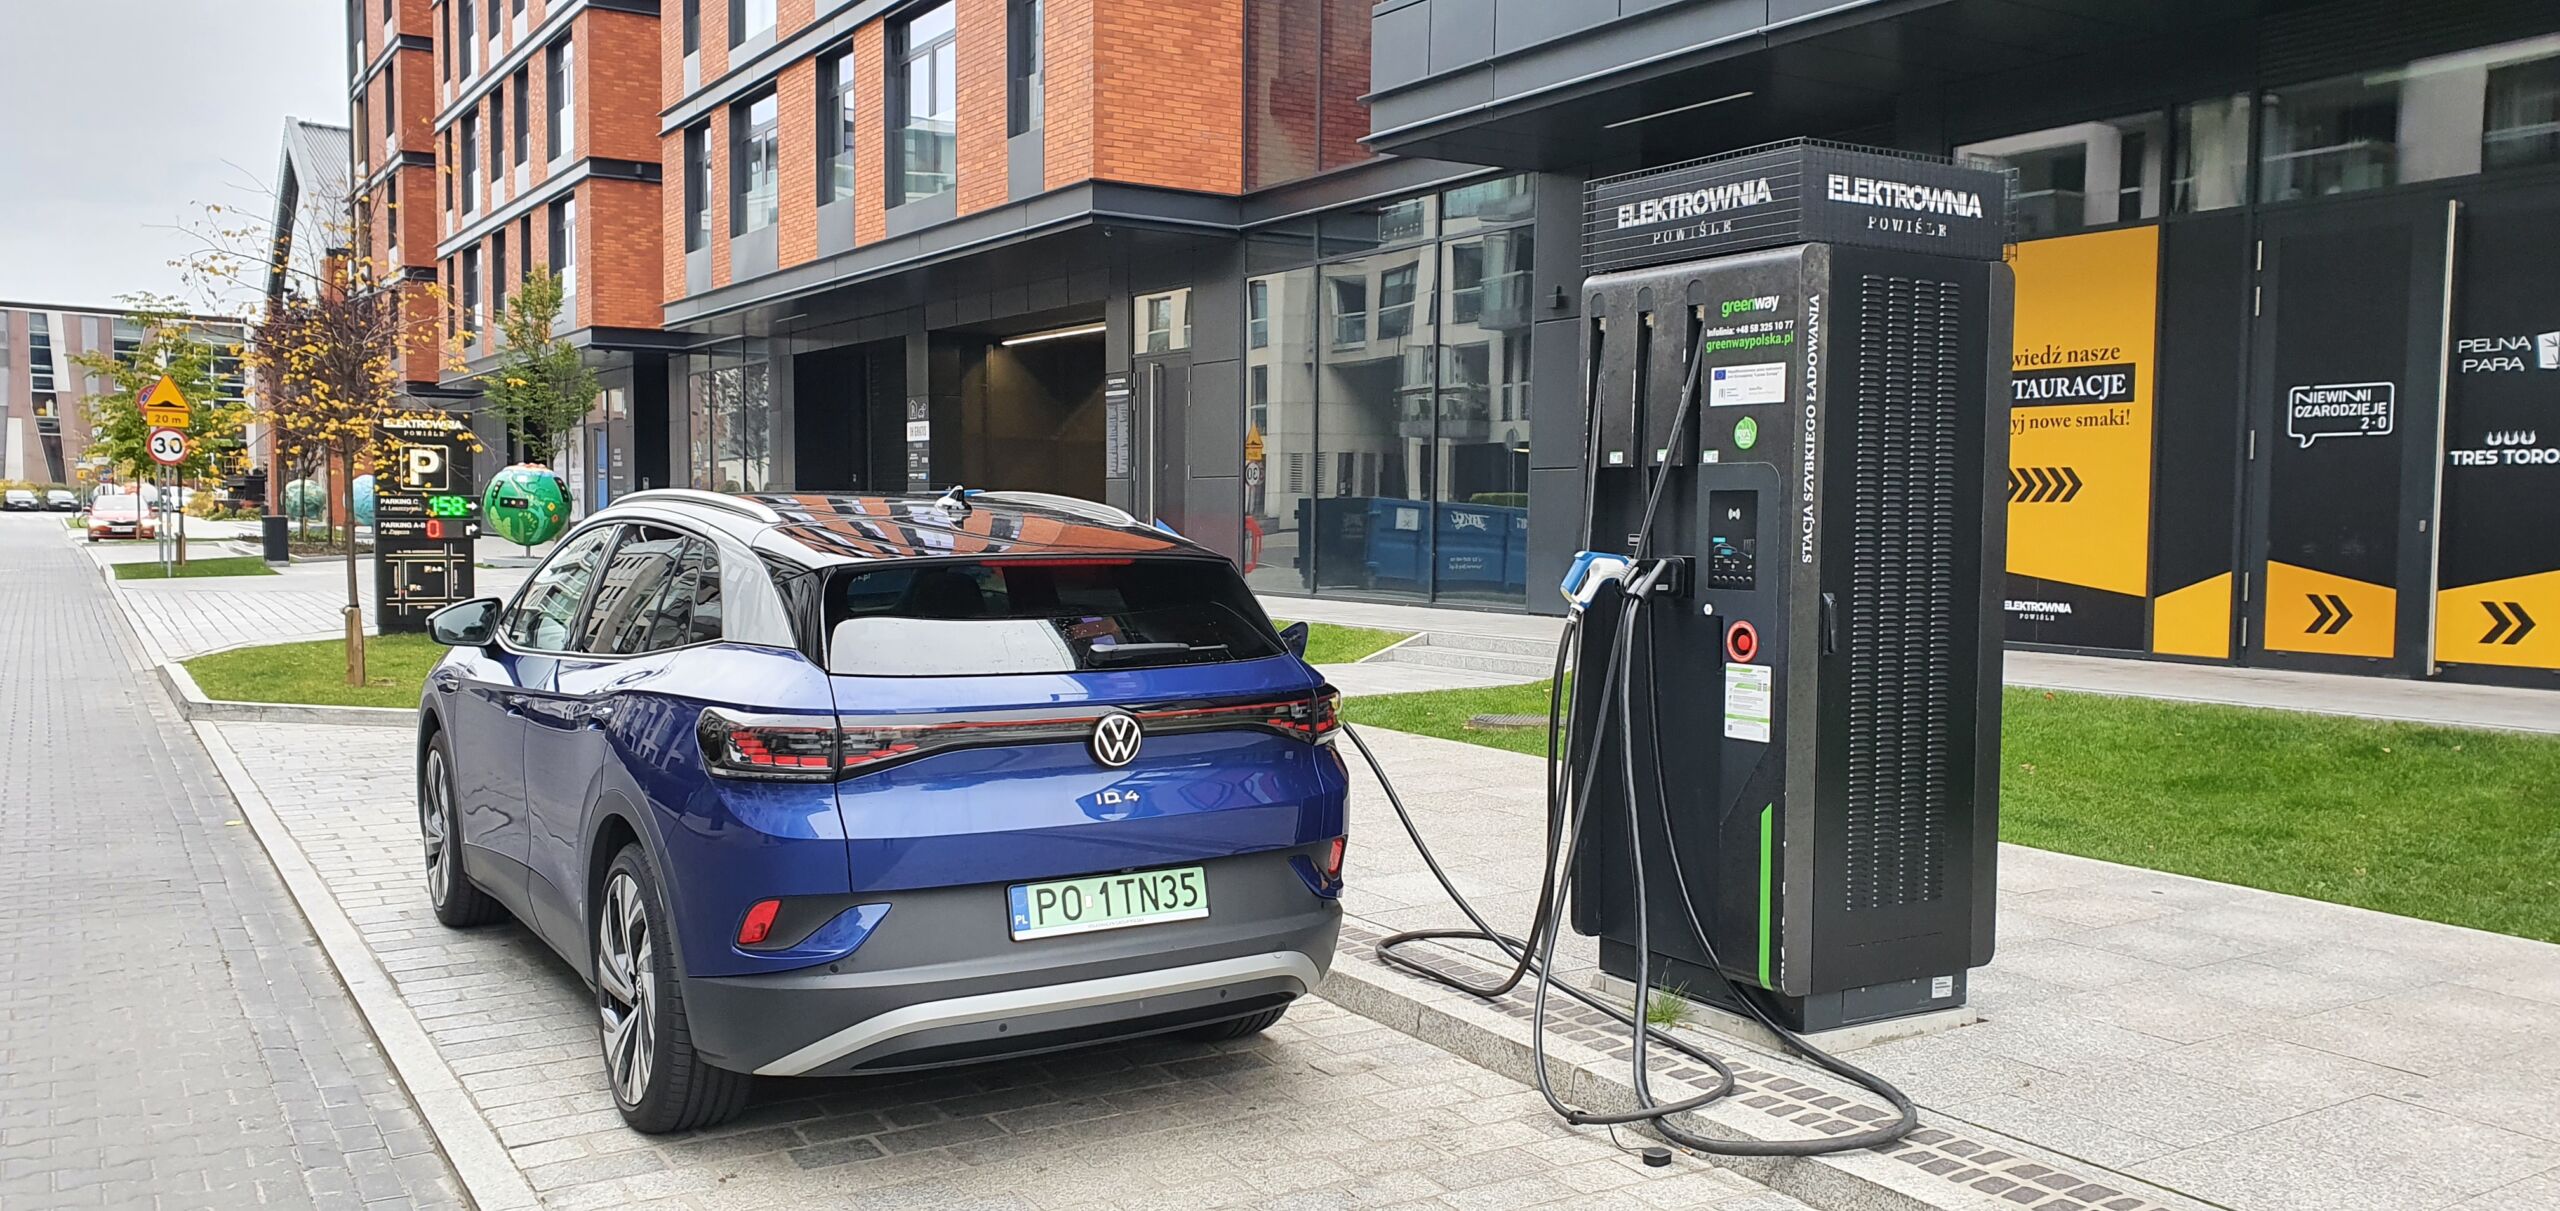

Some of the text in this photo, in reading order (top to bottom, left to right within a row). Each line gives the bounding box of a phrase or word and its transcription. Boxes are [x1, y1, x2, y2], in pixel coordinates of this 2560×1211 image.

[1617, 176, 1773, 229] ELEKTROWNIA
[1827, 173, 1983, 219] ELEKTROWNIA
[1652, 220, 1733, 245] POWIŚLE
[1868, 215, 1948, 237] POWIŚLE
[1721, 295, 1780, 318] greenway
[1706, 327, 1735, 337] Infolinia:
[1760, 322, 1773, 332] 325
[1774, 321, 1784, 330] 10
[1784, 320, 1794, 329] 77
[1706, 330, 1794, 353] greenwaypolska.pl
[2067, 346, 2121, 363] nasze
[2011, 373, 2127, 400] TAURACJE
[2295, 388, 2372, 404] NIEWINNI
[155, 415, 169, 423] 20
[2029, 417, 2072, 429] nowe
[2075, 408, 2131, 428] smaki!
[2294, 401, 2388, 418] CZARODZIEJE
[1802, 294, 1820, 564] STACJA SZYBKIEGO ŁADOWANIA
[154, 437, 183, 454] 30
[2450, 448, 2560, 466] TRES TORO
[409, 449, 440, 486] P
[429, 496, 464, 516] 158
[380, 521, 412, 529] PARKING
[427, 520, 440, 538] 0
[2004, 600, 2073, 614] ELEKTROWNIA
[1036, 872, 1199, 926] PO 1TN35
[1015, 914, 1029, 928] PL
